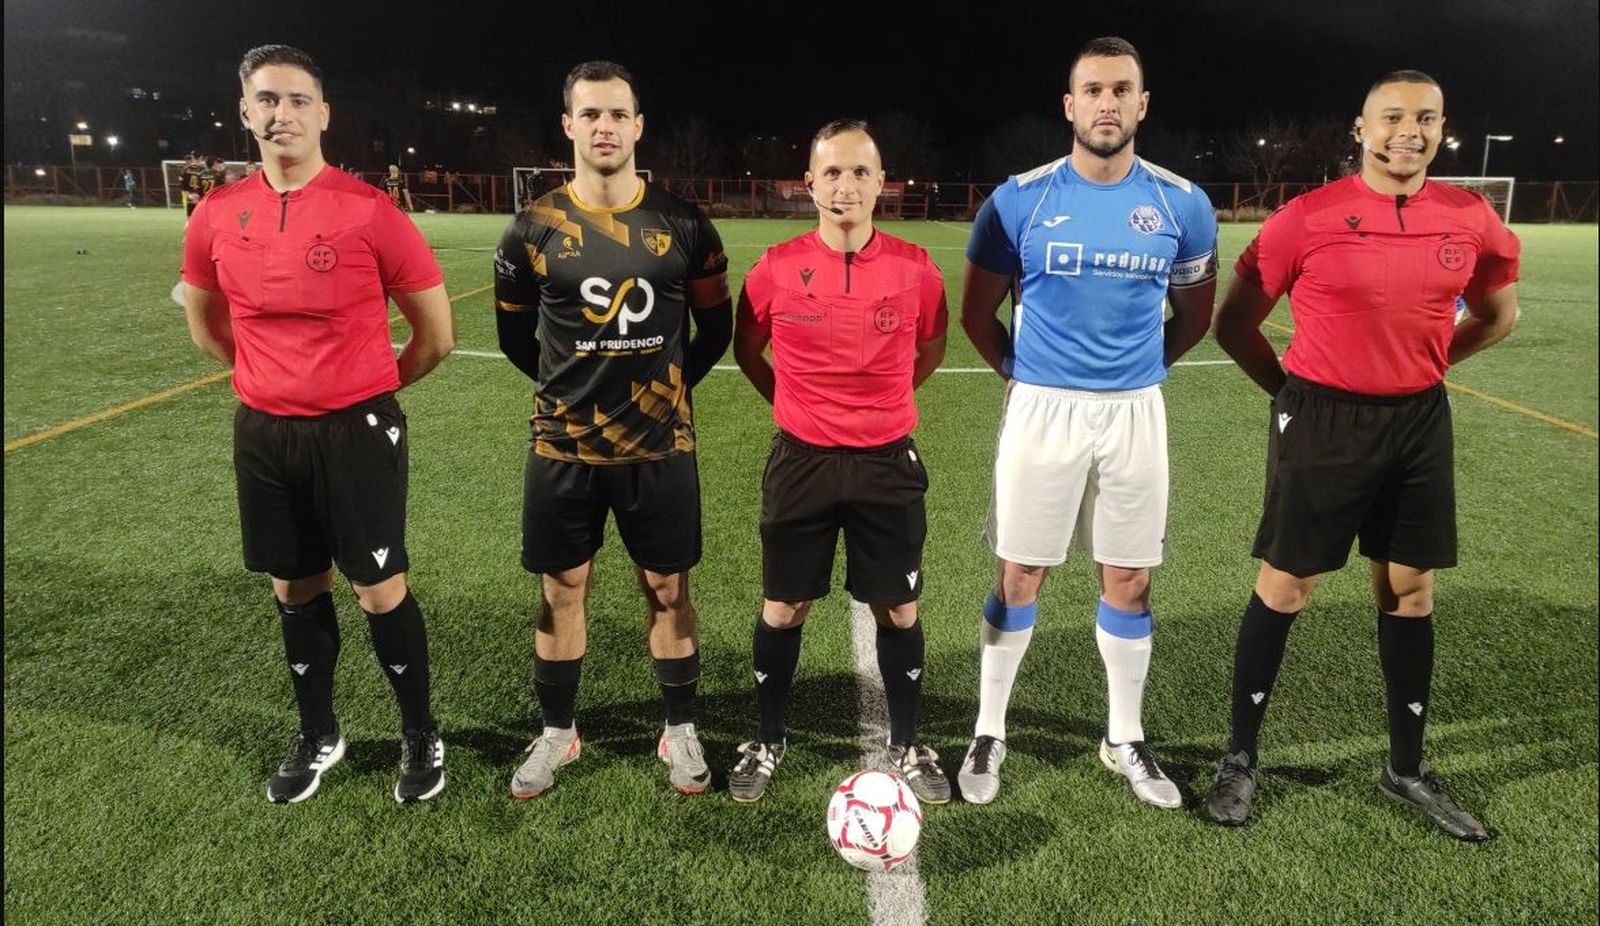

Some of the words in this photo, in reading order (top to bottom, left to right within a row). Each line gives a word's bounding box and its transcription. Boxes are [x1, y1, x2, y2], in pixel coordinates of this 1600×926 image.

[1094, 251, 1166, 271] redpiso
[575, 339, 597, 351] SAN
[600, 335, 664, 349] PRUDENCIO
